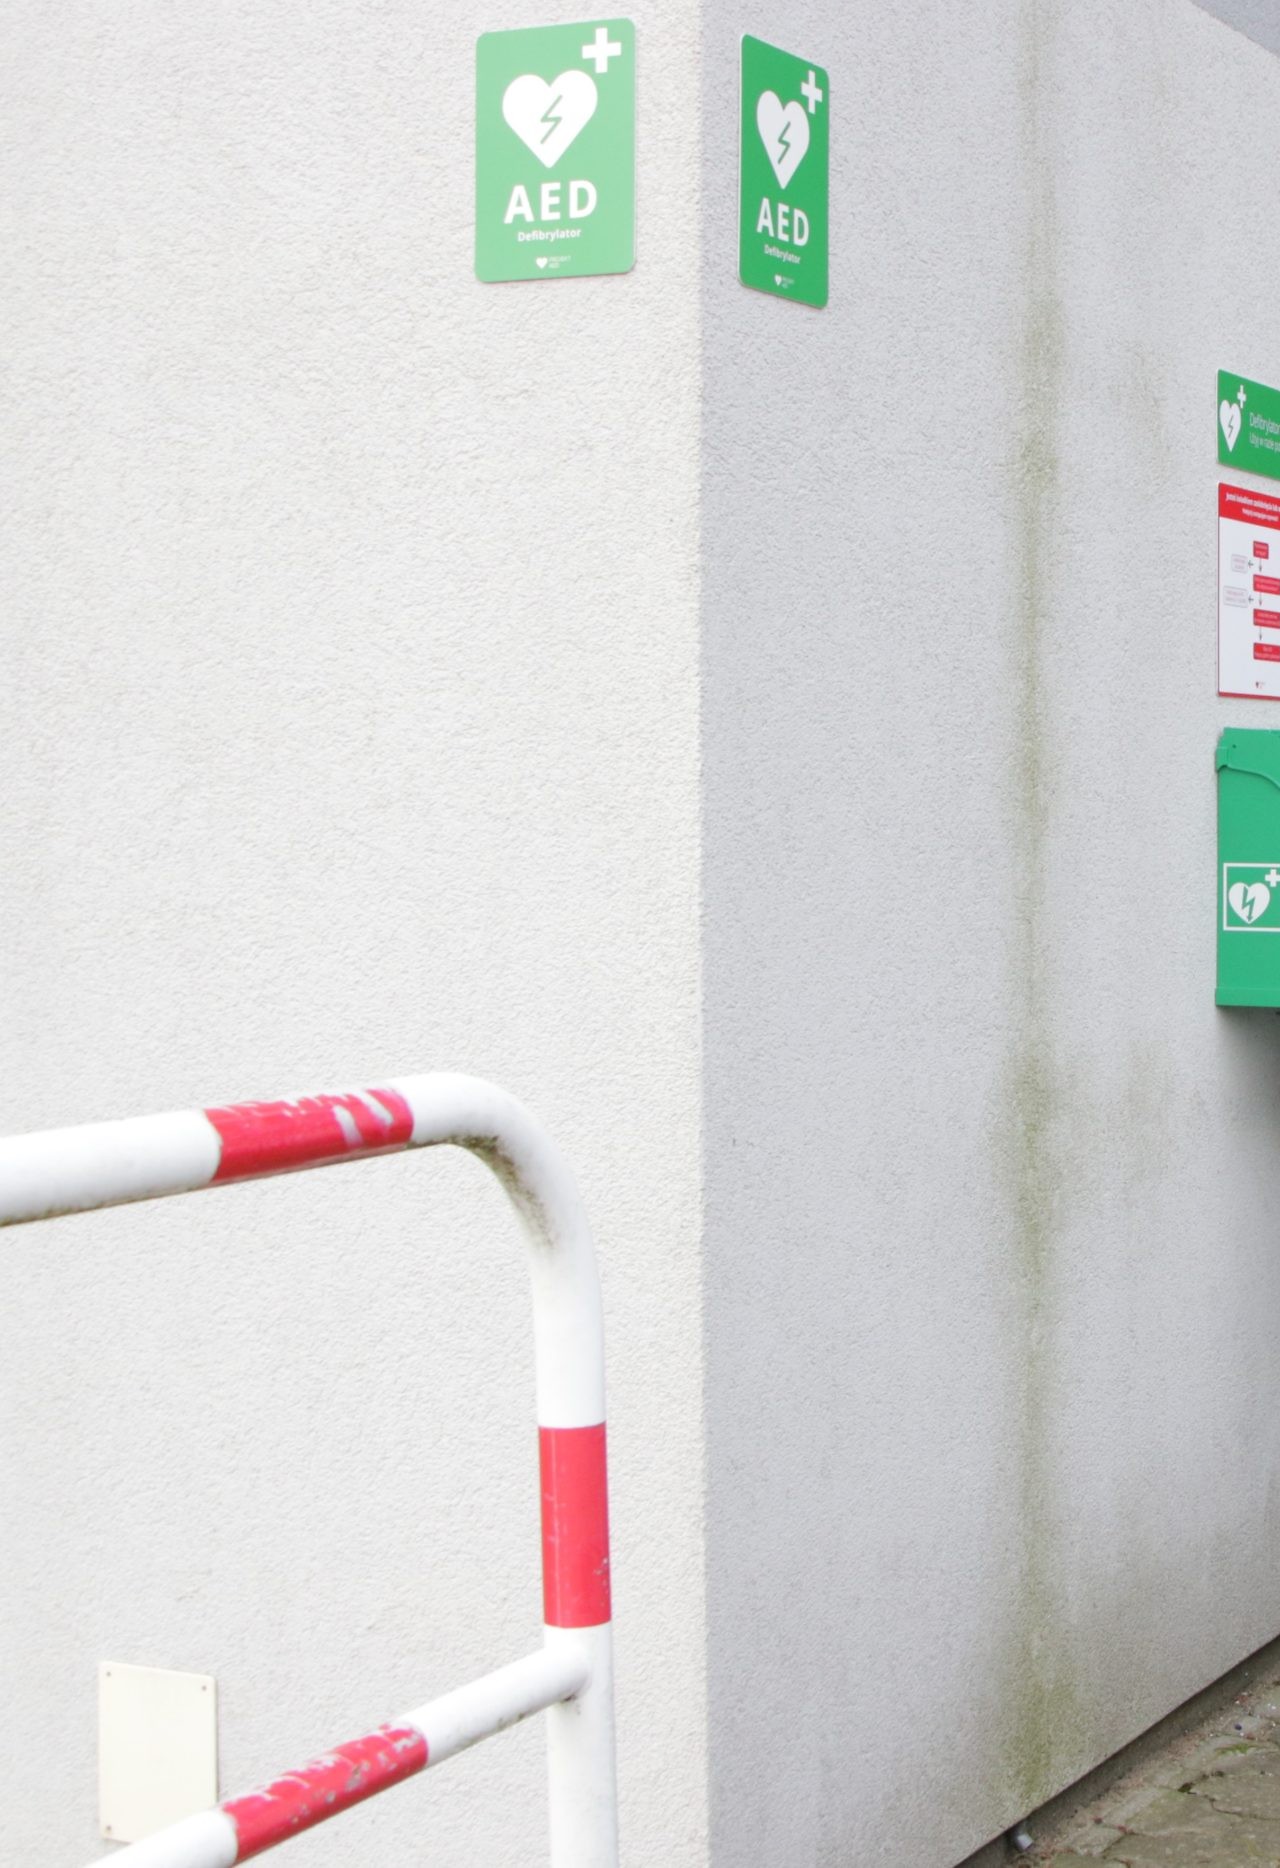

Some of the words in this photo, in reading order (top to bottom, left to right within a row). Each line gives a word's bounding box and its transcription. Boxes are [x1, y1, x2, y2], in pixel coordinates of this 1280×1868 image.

[503, 179, 597, 224] AED
[757, 197, 809, 247] AED
[518, 229, 581, 242] Defibrylator
[764, 244, 801, 264] Defibrylator
[1249, 412, 1280, 435] Defibrylator
